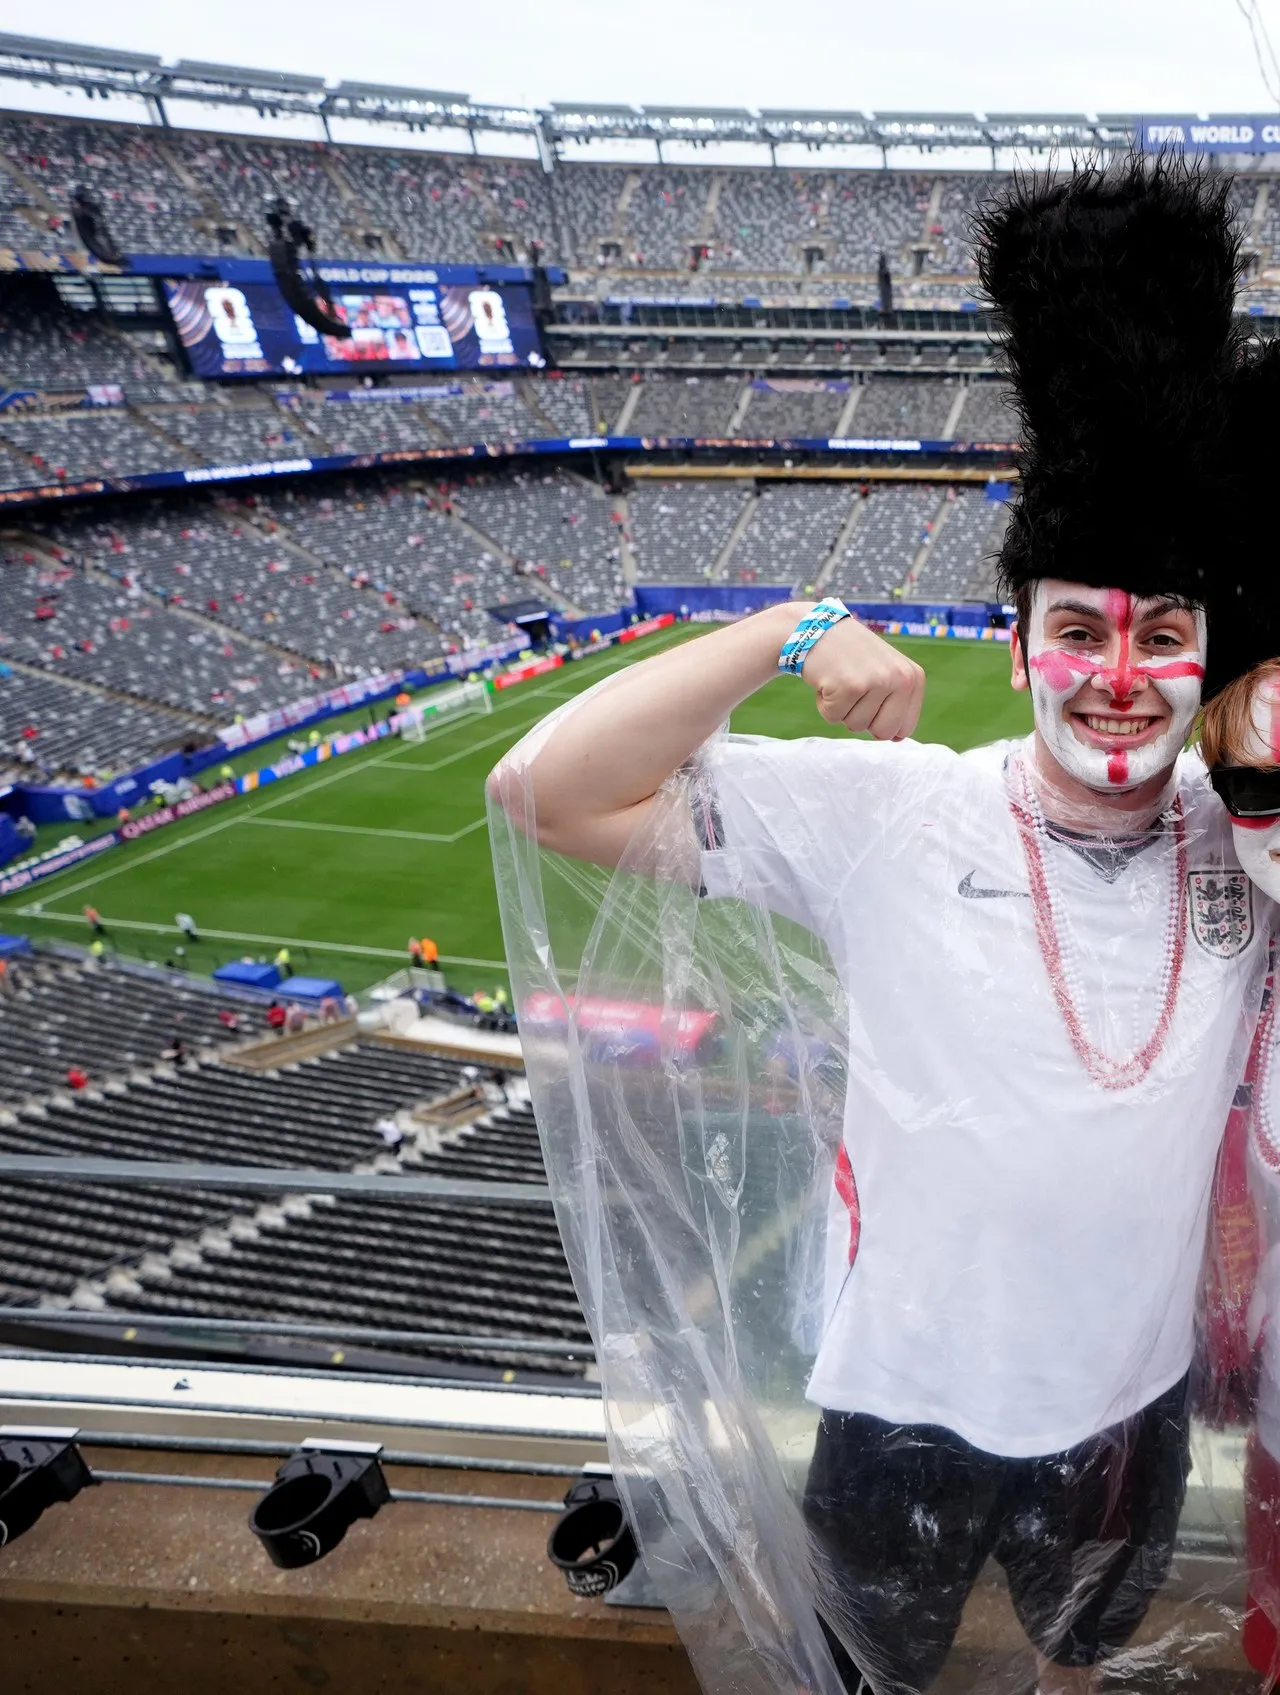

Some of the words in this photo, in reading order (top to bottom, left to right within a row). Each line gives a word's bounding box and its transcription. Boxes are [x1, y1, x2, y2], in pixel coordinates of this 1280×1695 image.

[1147, 126, 1185, 144] FIFA
[1190, 126, 1254, 144] WORLD
[121, 807, 175, 839] QATAR
